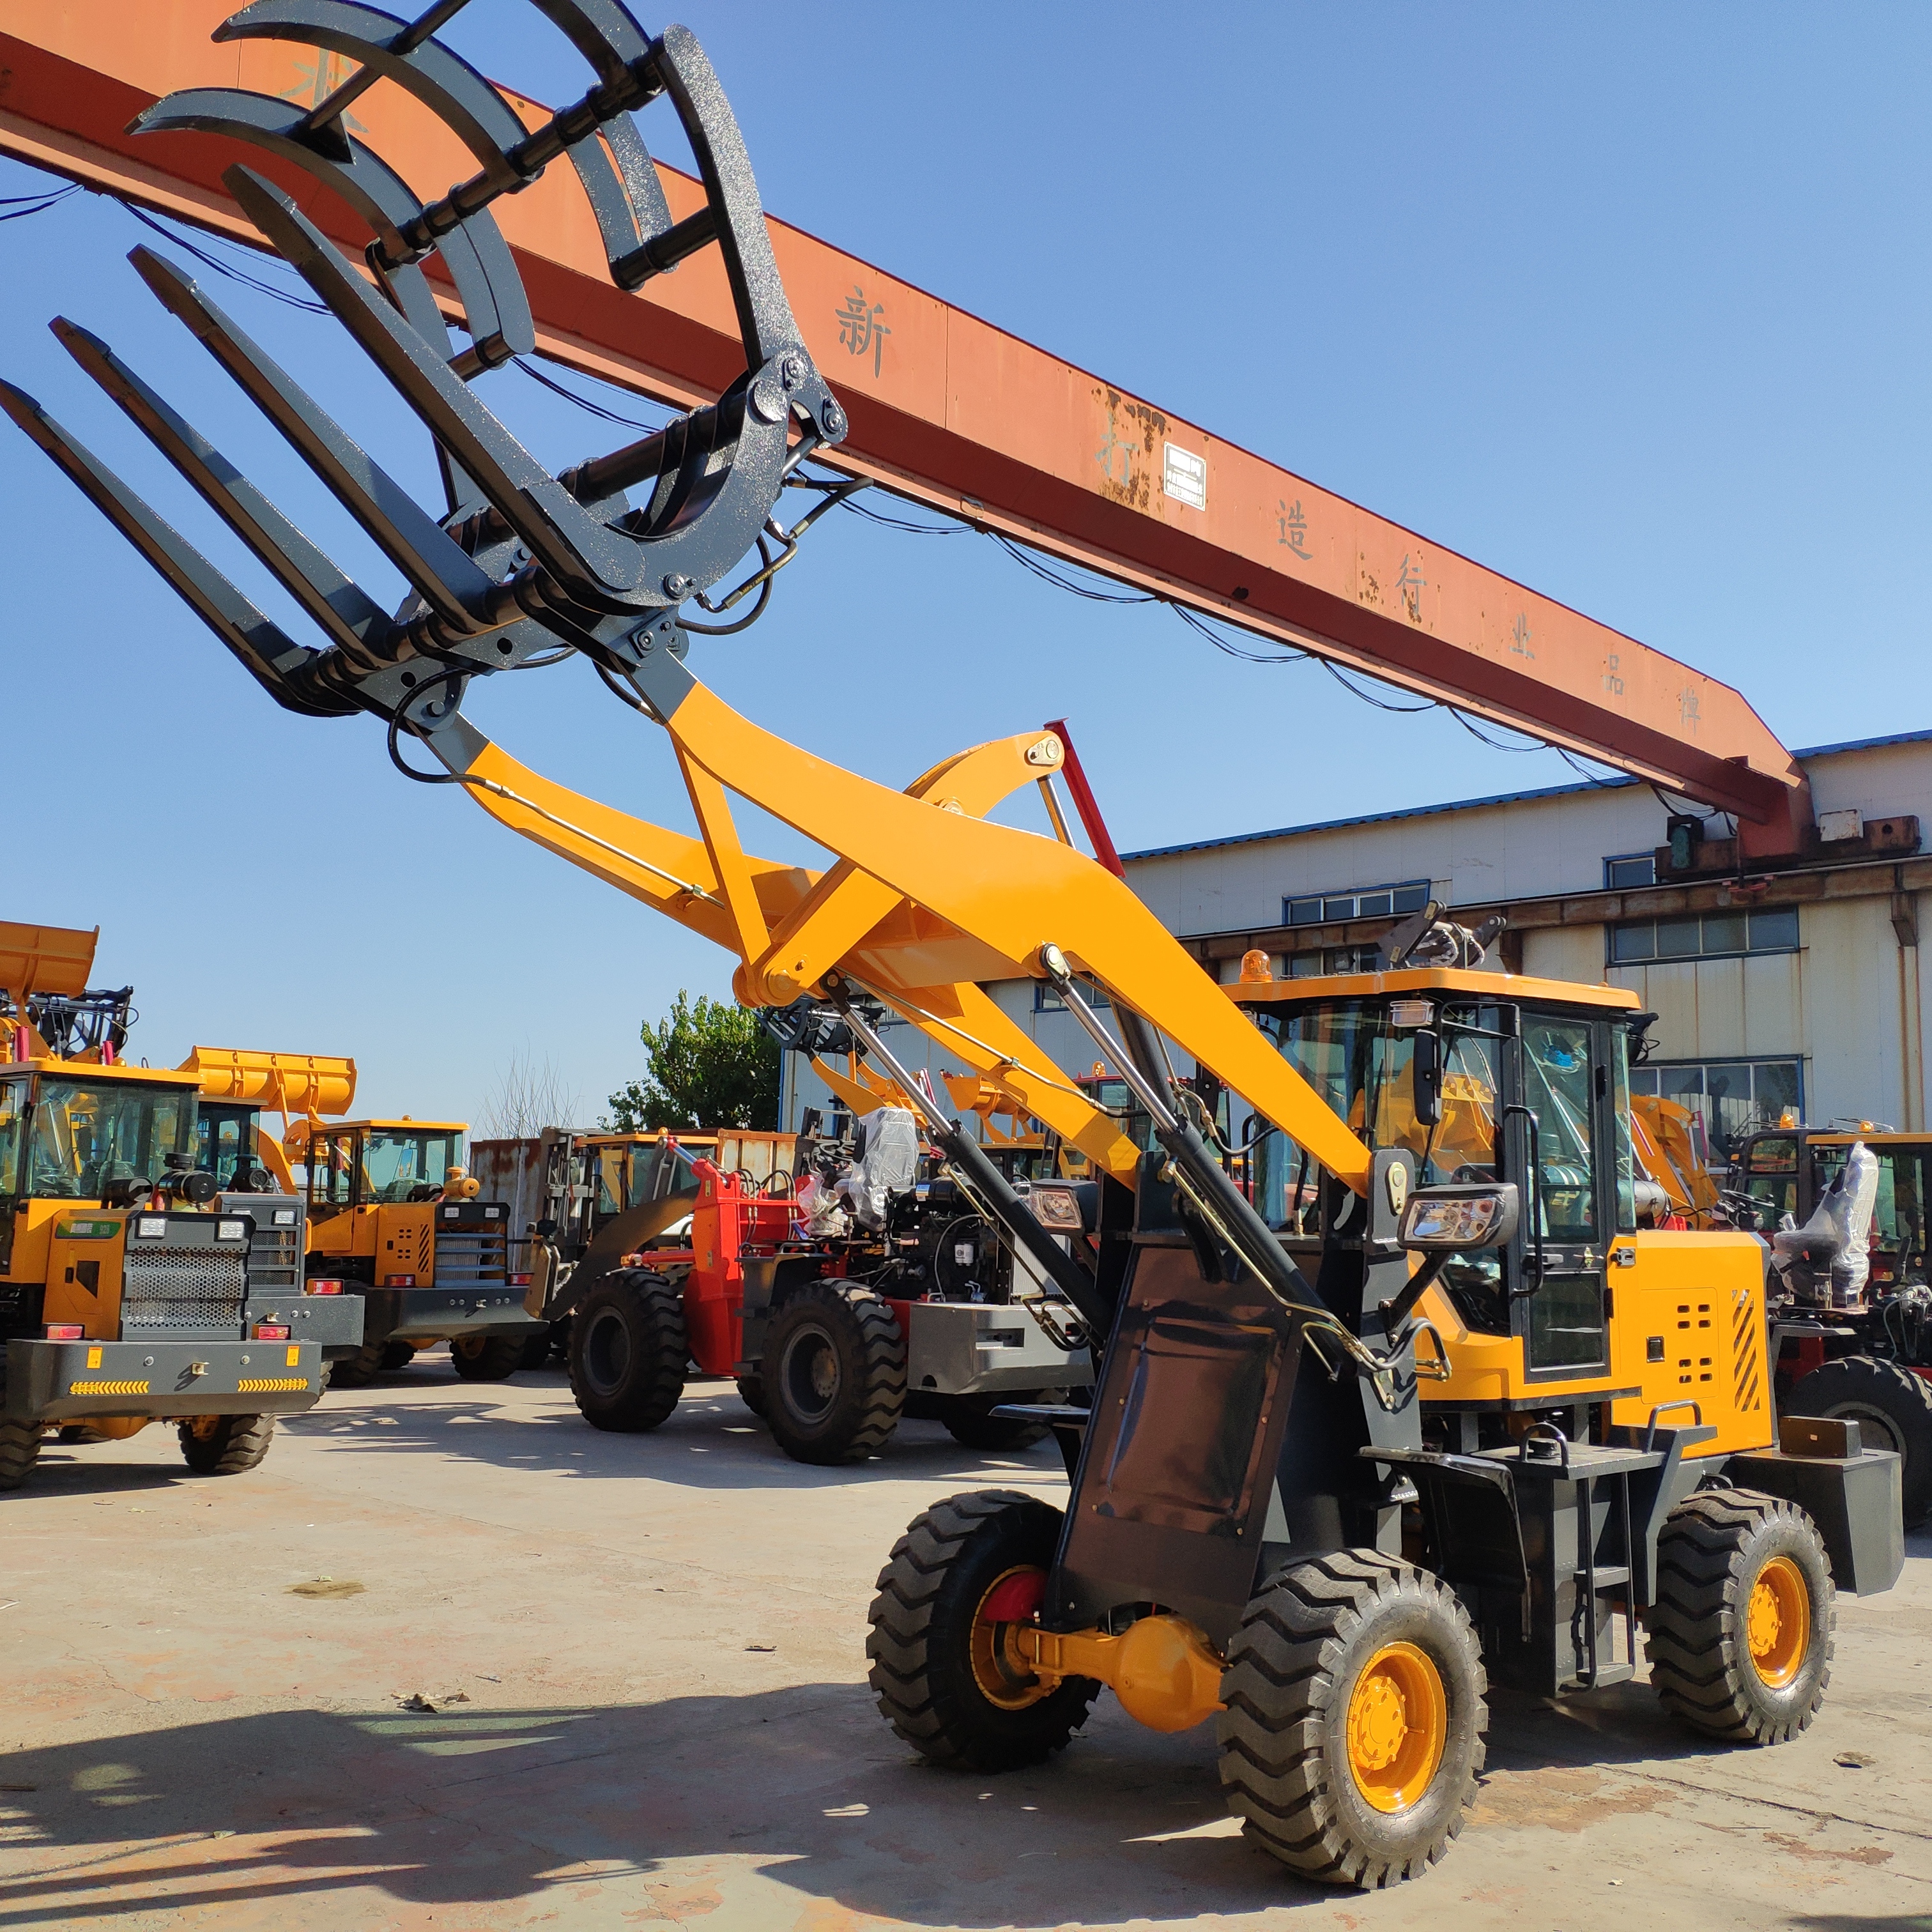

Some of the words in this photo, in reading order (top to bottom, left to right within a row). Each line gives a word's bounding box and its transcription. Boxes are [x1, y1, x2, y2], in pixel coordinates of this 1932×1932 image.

[834, 285, 892, 379] 新
[1094, 411, 1139, 487] 打
[1277, 500, 1313, 560] 造
[1395, 553, 1427, 617] 行
[1508, 612, 1535, 659] 业
[1602, 654, 1624, 695] 品
